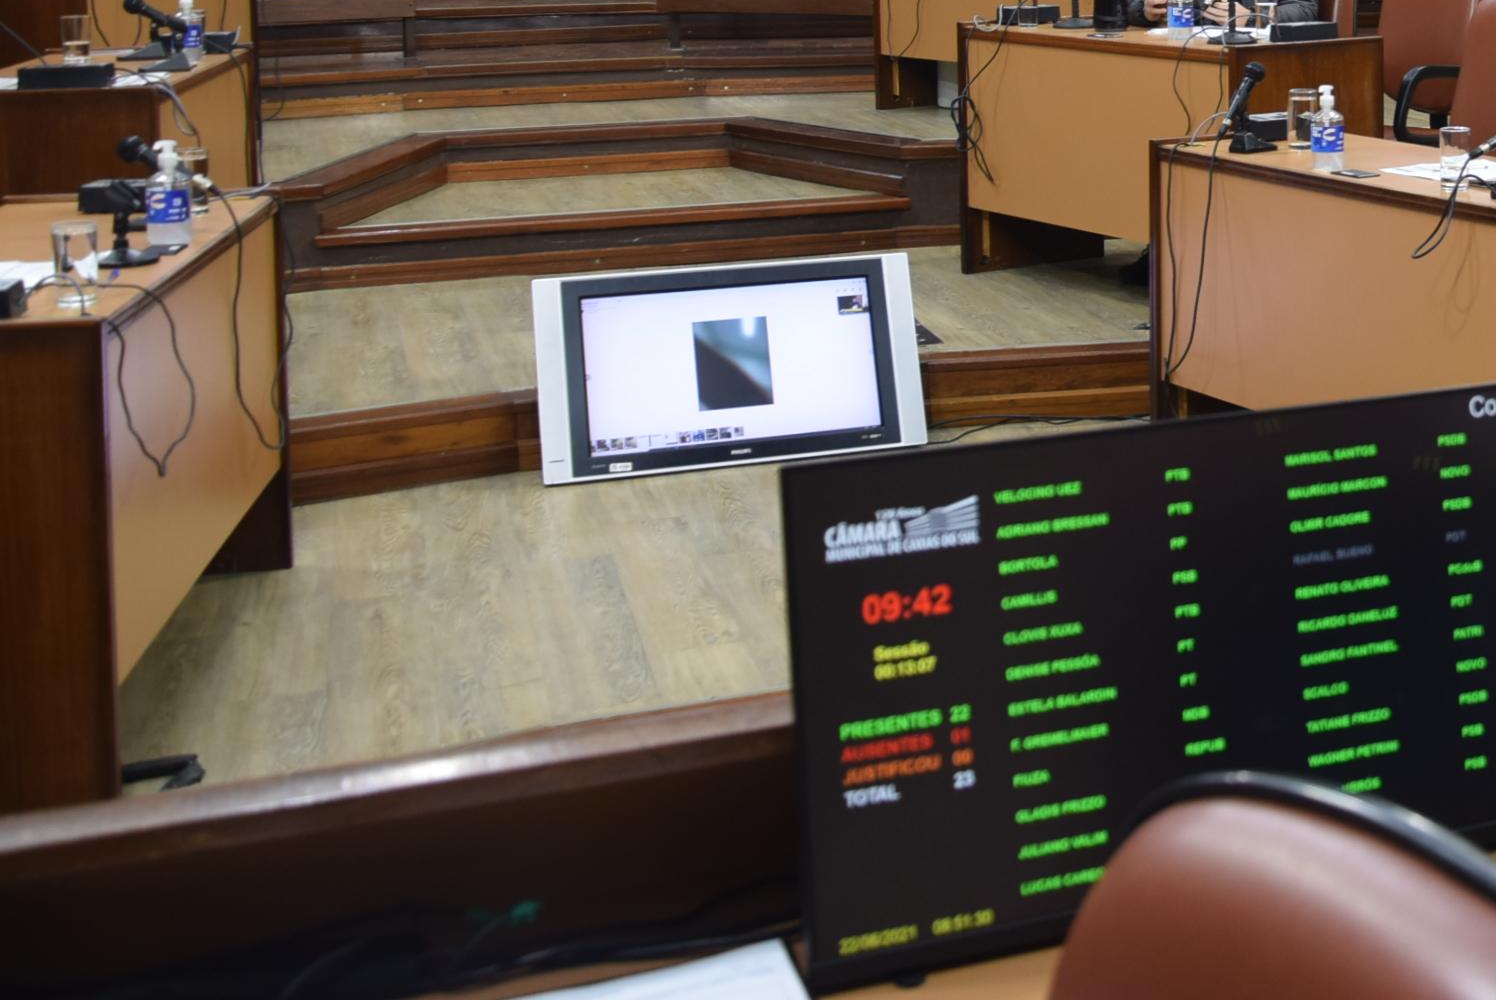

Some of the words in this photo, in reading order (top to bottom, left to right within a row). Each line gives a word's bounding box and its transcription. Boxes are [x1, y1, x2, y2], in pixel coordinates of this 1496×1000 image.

[1284, 450, 1333, 467] MARISOL
[1331, 444, 1378, 461] SANTOS
[1339, 476, 1388, 493] MARCON
[1439, 464, 1471, 479] NOVO
[996, 520, 1052, 539] ADRIANO
[1323, 510, 1371, 528] CADORE
[824, 520, 901, 548] CÂMARA
[825, 543, 885, 564] MUNICIPAL
[903, 536, 940, 552] CAXIAS
[1294, 582, 1341, 600] RENATO
[1339, 574, 1390, 593] OLIVEIRA
[861, 583, 952, 625] 09:42
[1297, 614, 1348, 633] RICARDO
[1346, 605, 1398, 625] DANELUZ
[1300, 648, 1347, 667] SANDRO
[1345, 639, 1398, 658] FANTINEL
[1455, 656, 1487, 673] NOVO
[1005, 661, 1051, 681] DENISE
[839, 708, 943, 742] PRESENTES
[949, 703, 971, 723] 22
[1306, 714, 1352, 733] TATIANE
[1350, 707, 1391, 725] FRIZZO
[841, 733, 934, 764] AUSENTES
[1307, 747, 1357, 767] WAGNER
[1355, 739, 1399, 758] PETRINI
[843, 754, 943, 787] JUSTIFICOU
[844, 784, 901, 808] TOTAL
[953, 769, 976, 790] 23
